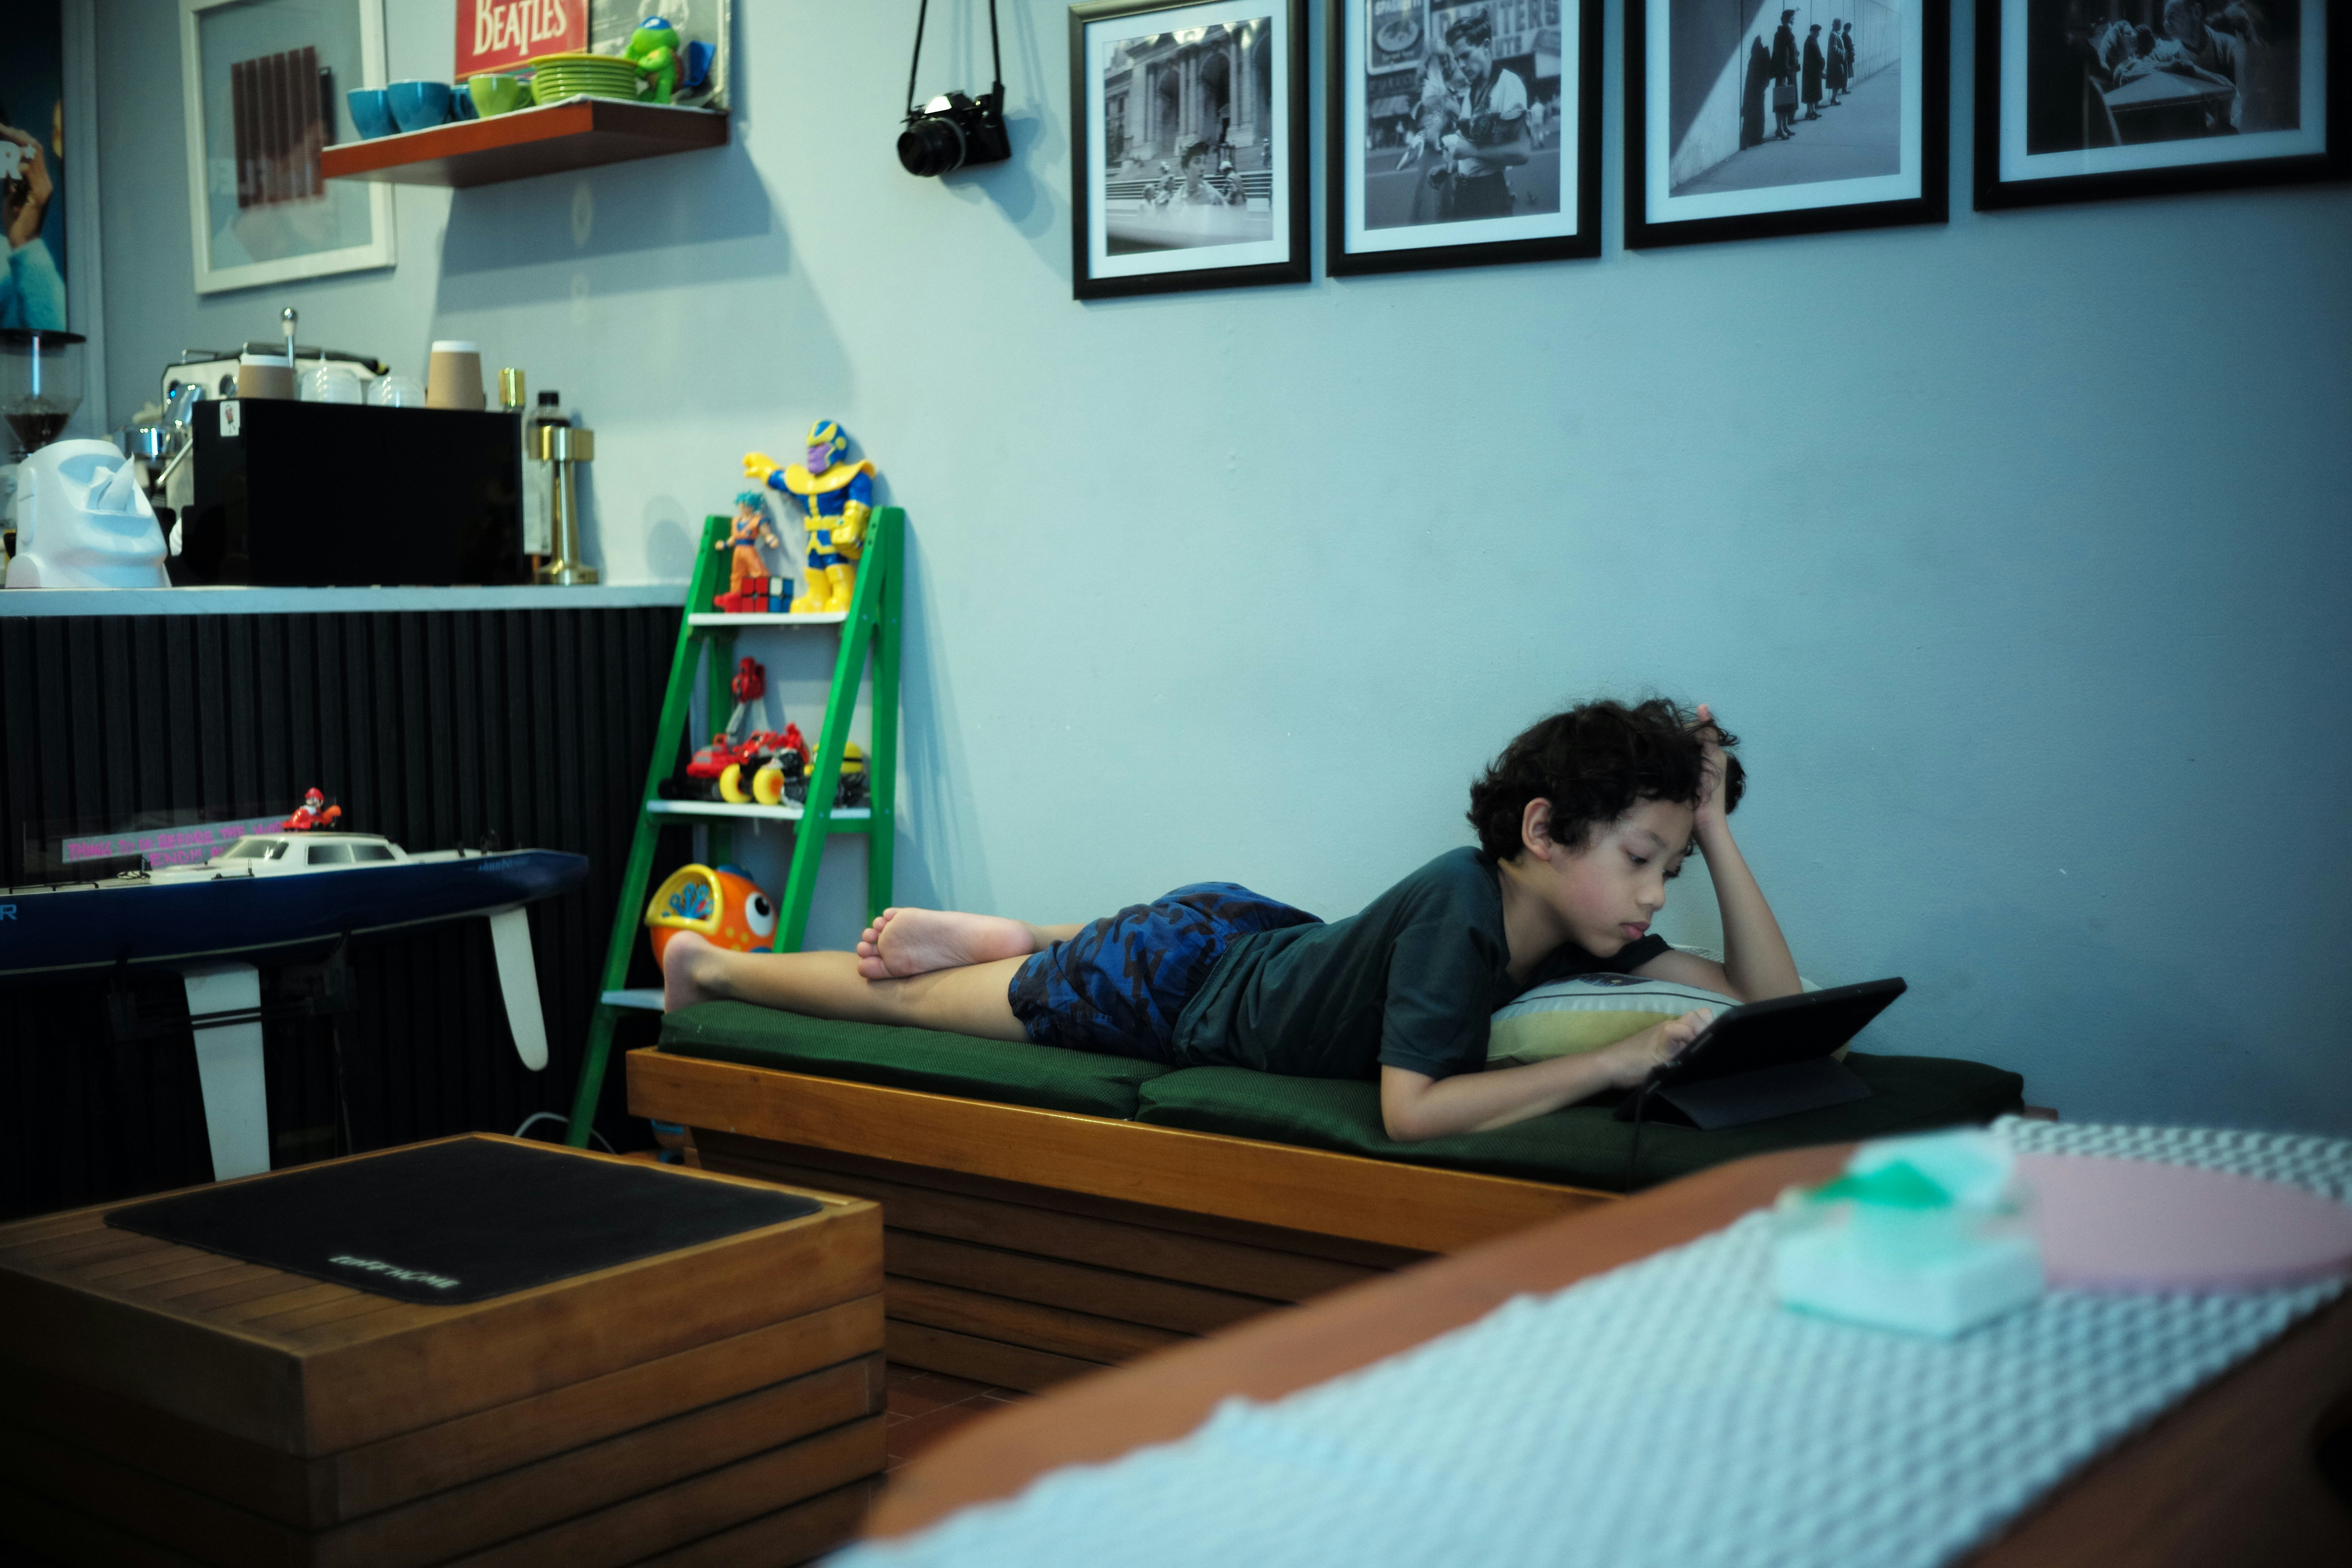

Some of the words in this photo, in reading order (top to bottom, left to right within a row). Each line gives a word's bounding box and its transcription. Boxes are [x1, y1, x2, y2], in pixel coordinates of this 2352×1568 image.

[473, 0, 567, 56] BEATLES
[68, 841, 112, 861] THINGS
[158, 830, 214, 849] BEFORE
